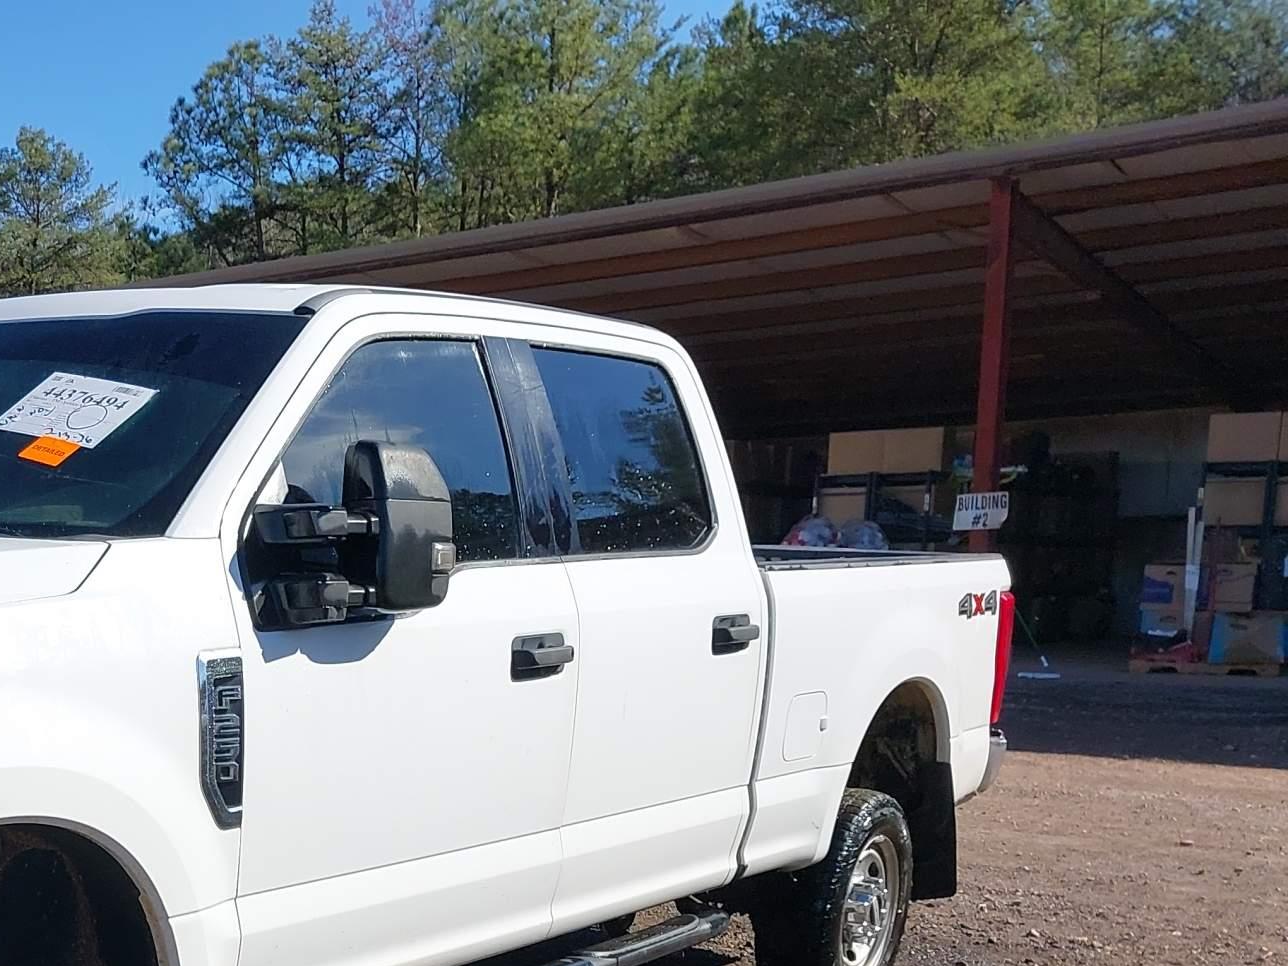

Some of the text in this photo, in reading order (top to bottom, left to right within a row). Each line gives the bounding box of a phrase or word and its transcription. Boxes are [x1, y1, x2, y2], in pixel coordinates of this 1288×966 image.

[42, 386, 130, 410] 44376494
[32, 444, 66, 457] DETAILED
[957, 494, 1007, 512] BUILDING
[971, 513, 989, 528] #2
